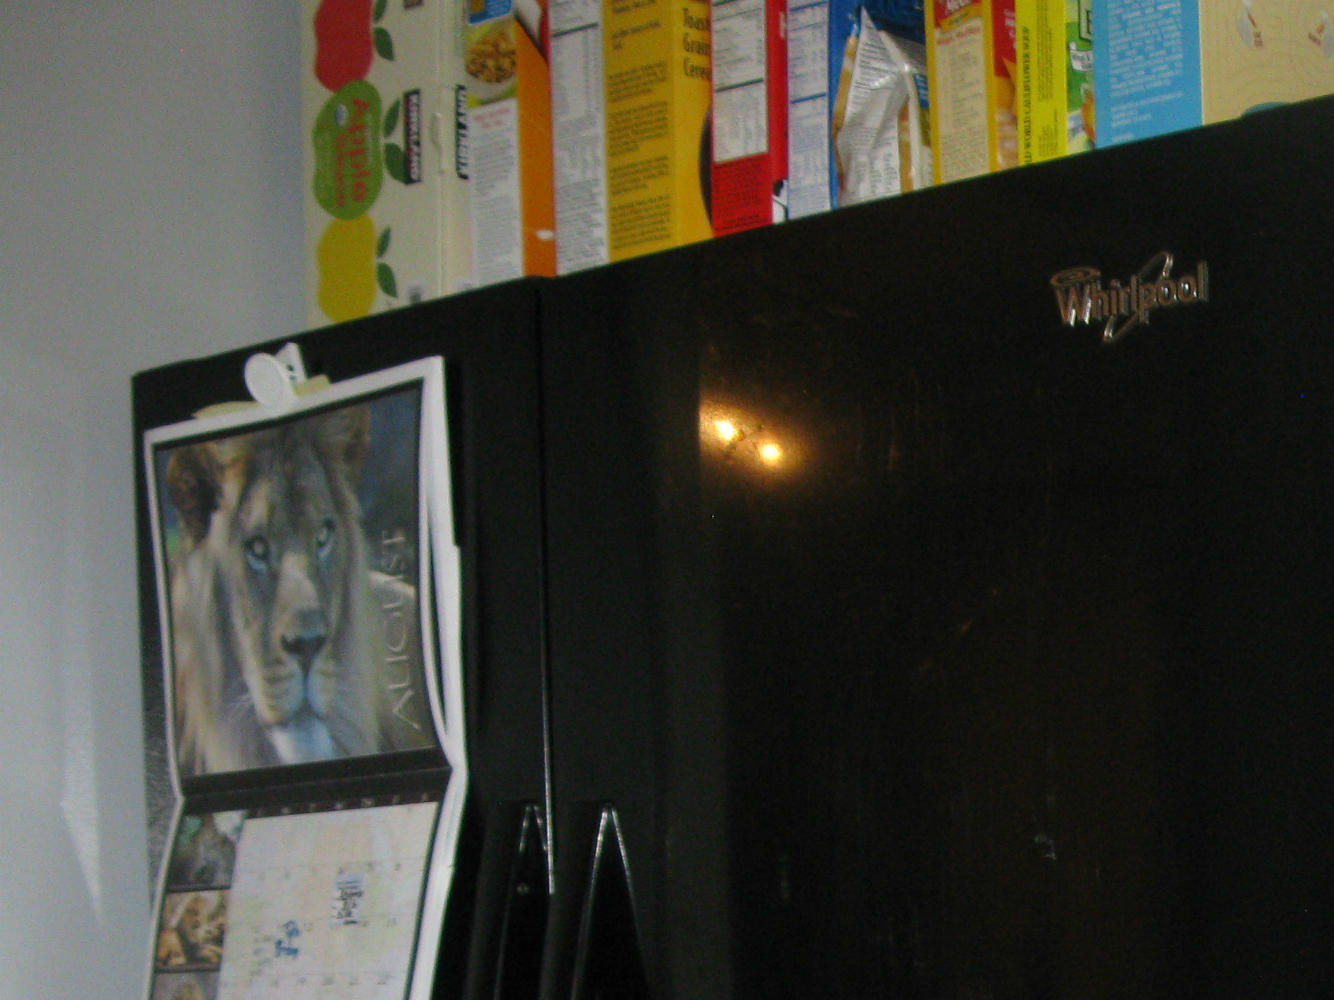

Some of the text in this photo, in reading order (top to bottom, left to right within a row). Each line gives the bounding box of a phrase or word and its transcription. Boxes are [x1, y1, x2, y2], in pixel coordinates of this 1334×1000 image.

[346, 98, 372, 203] Apple
[1051, 252, 1209, 342] Whirlpool
[381, 528, 422, 730] AUGUST
